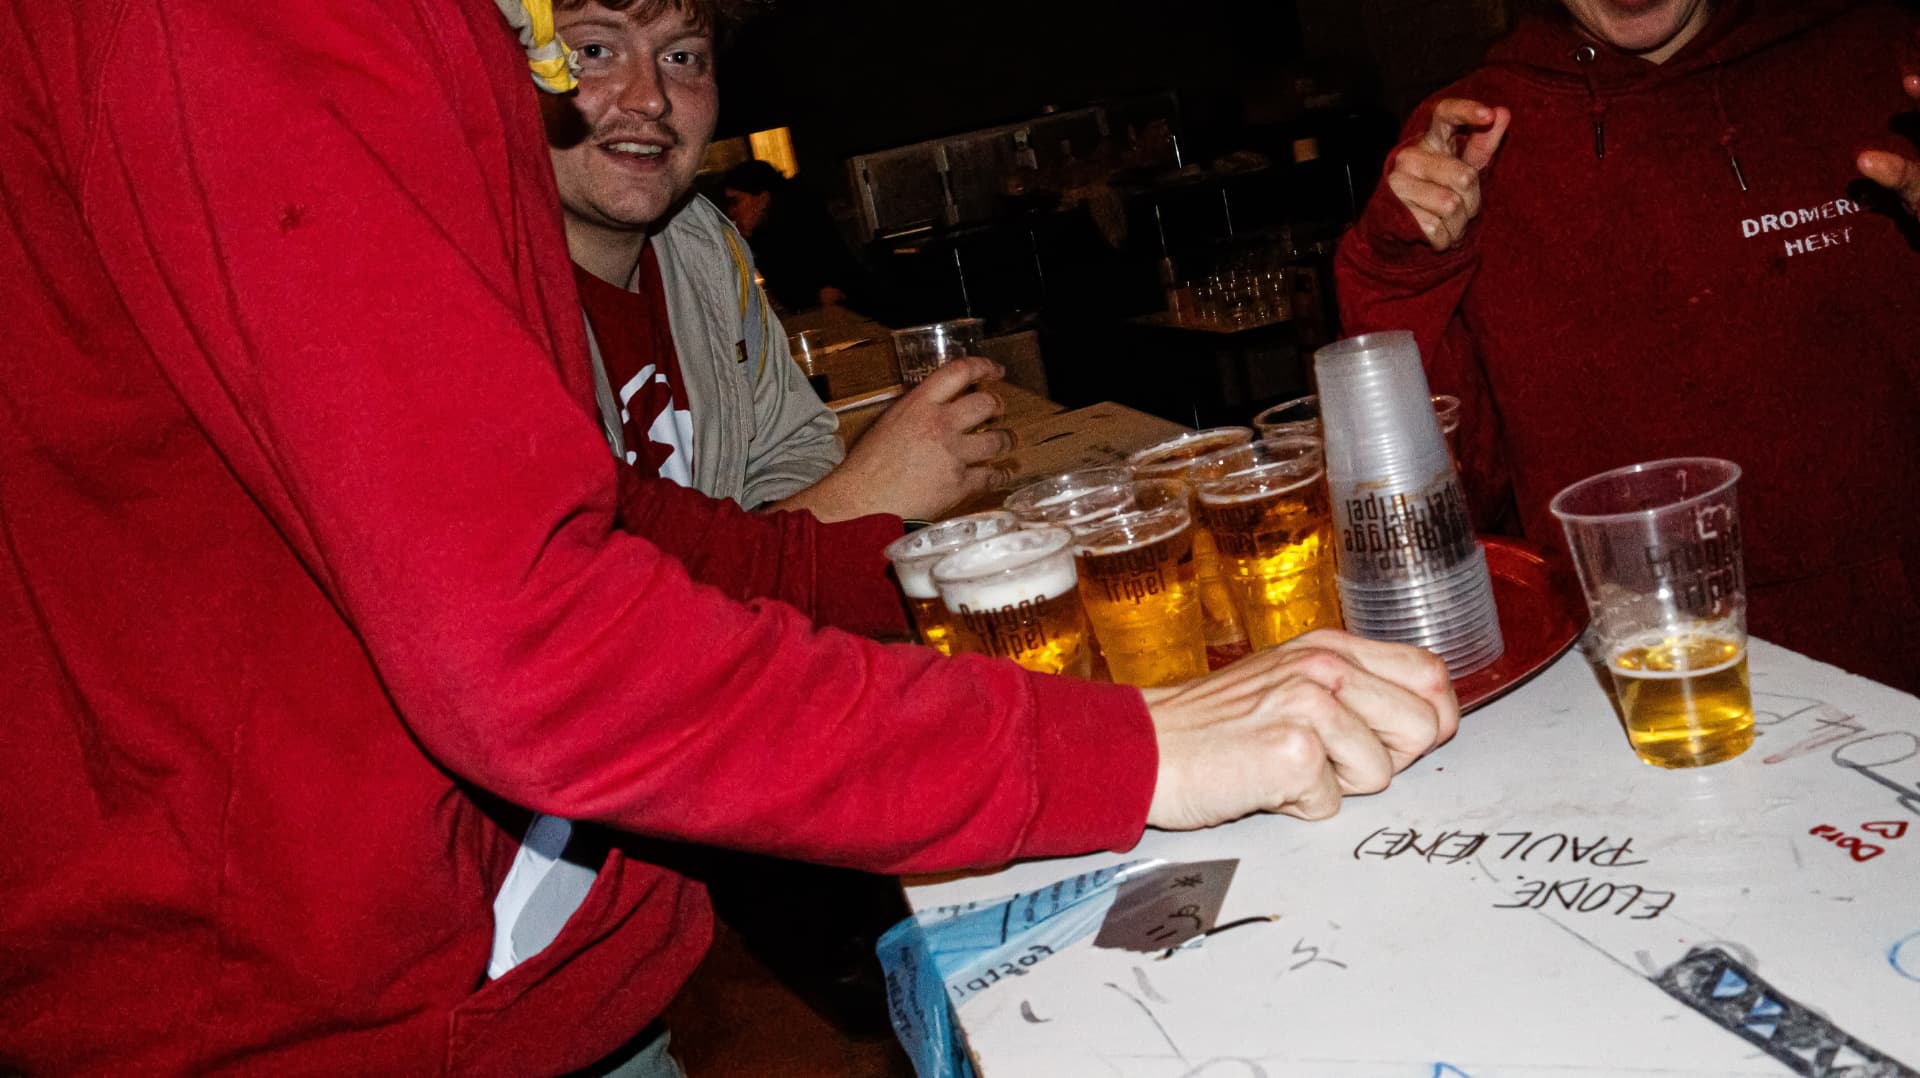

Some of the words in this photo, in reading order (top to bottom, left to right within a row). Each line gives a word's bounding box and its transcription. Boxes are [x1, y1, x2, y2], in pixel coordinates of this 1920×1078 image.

[1099, 568, 1167, 605] Tripel
[958, 594, 1048, 633] Brugge
[1808, 824, 1885, 863] Dora
